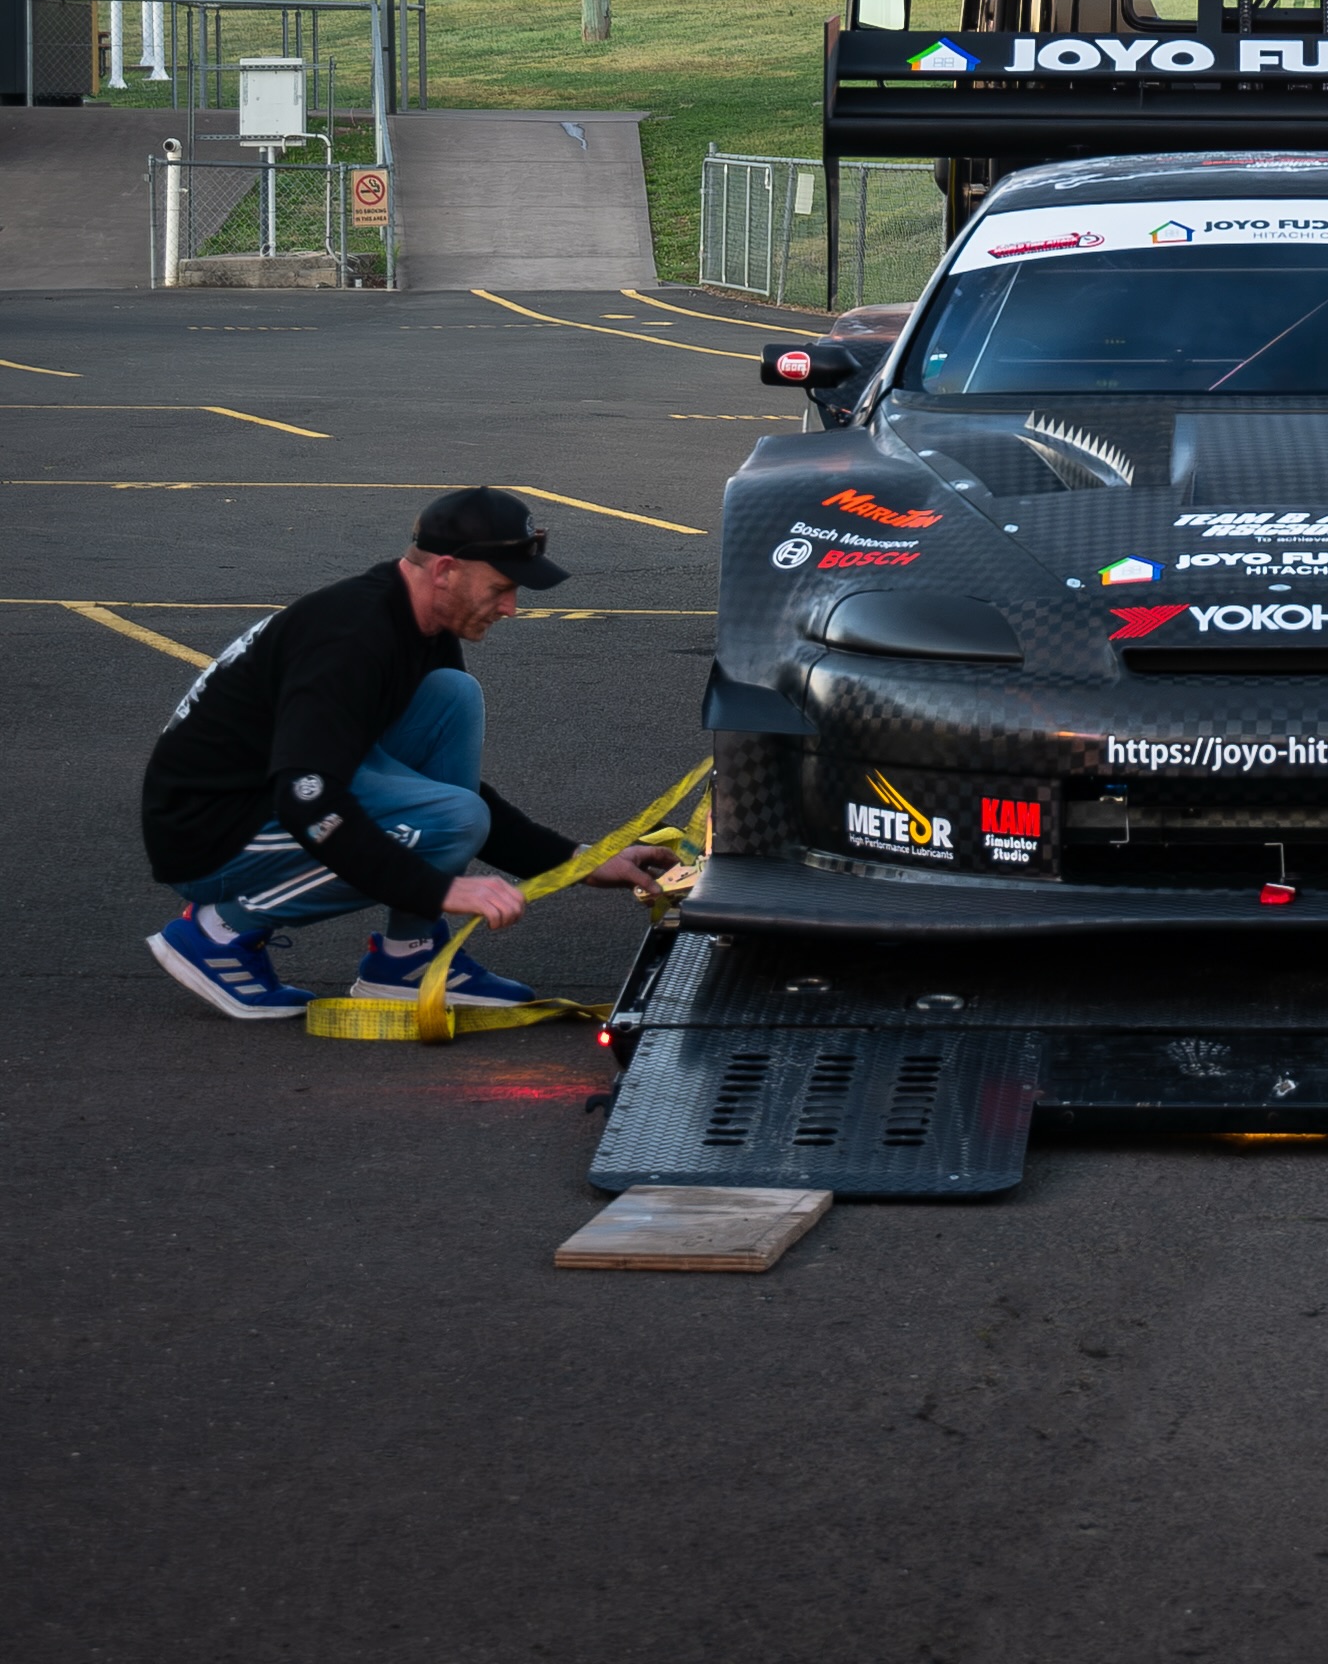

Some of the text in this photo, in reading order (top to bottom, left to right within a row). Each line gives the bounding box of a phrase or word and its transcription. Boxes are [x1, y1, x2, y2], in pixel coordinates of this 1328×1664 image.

[1004, 38, 1215, 72] JOYO
[1204, 220, 1271, 233] JOYO
[1252, 231, 1316, 240] HITACHI
[1173, 512, 1276, 526] TEAM
[790, 522, 919, 549] Bosch Motorsport
[817, 549, 921, 569] BOSCH
[1175, 553, 1272, 570] JOYO
[848, 800, 954, 849] METEOR
[981, 797, 1041, 837] KAM
[849, 834, 954, 860] High Performance Lubricants
[985, 834, 1038, 851] Simulator
[993, 847, 1030, 862] Studio
